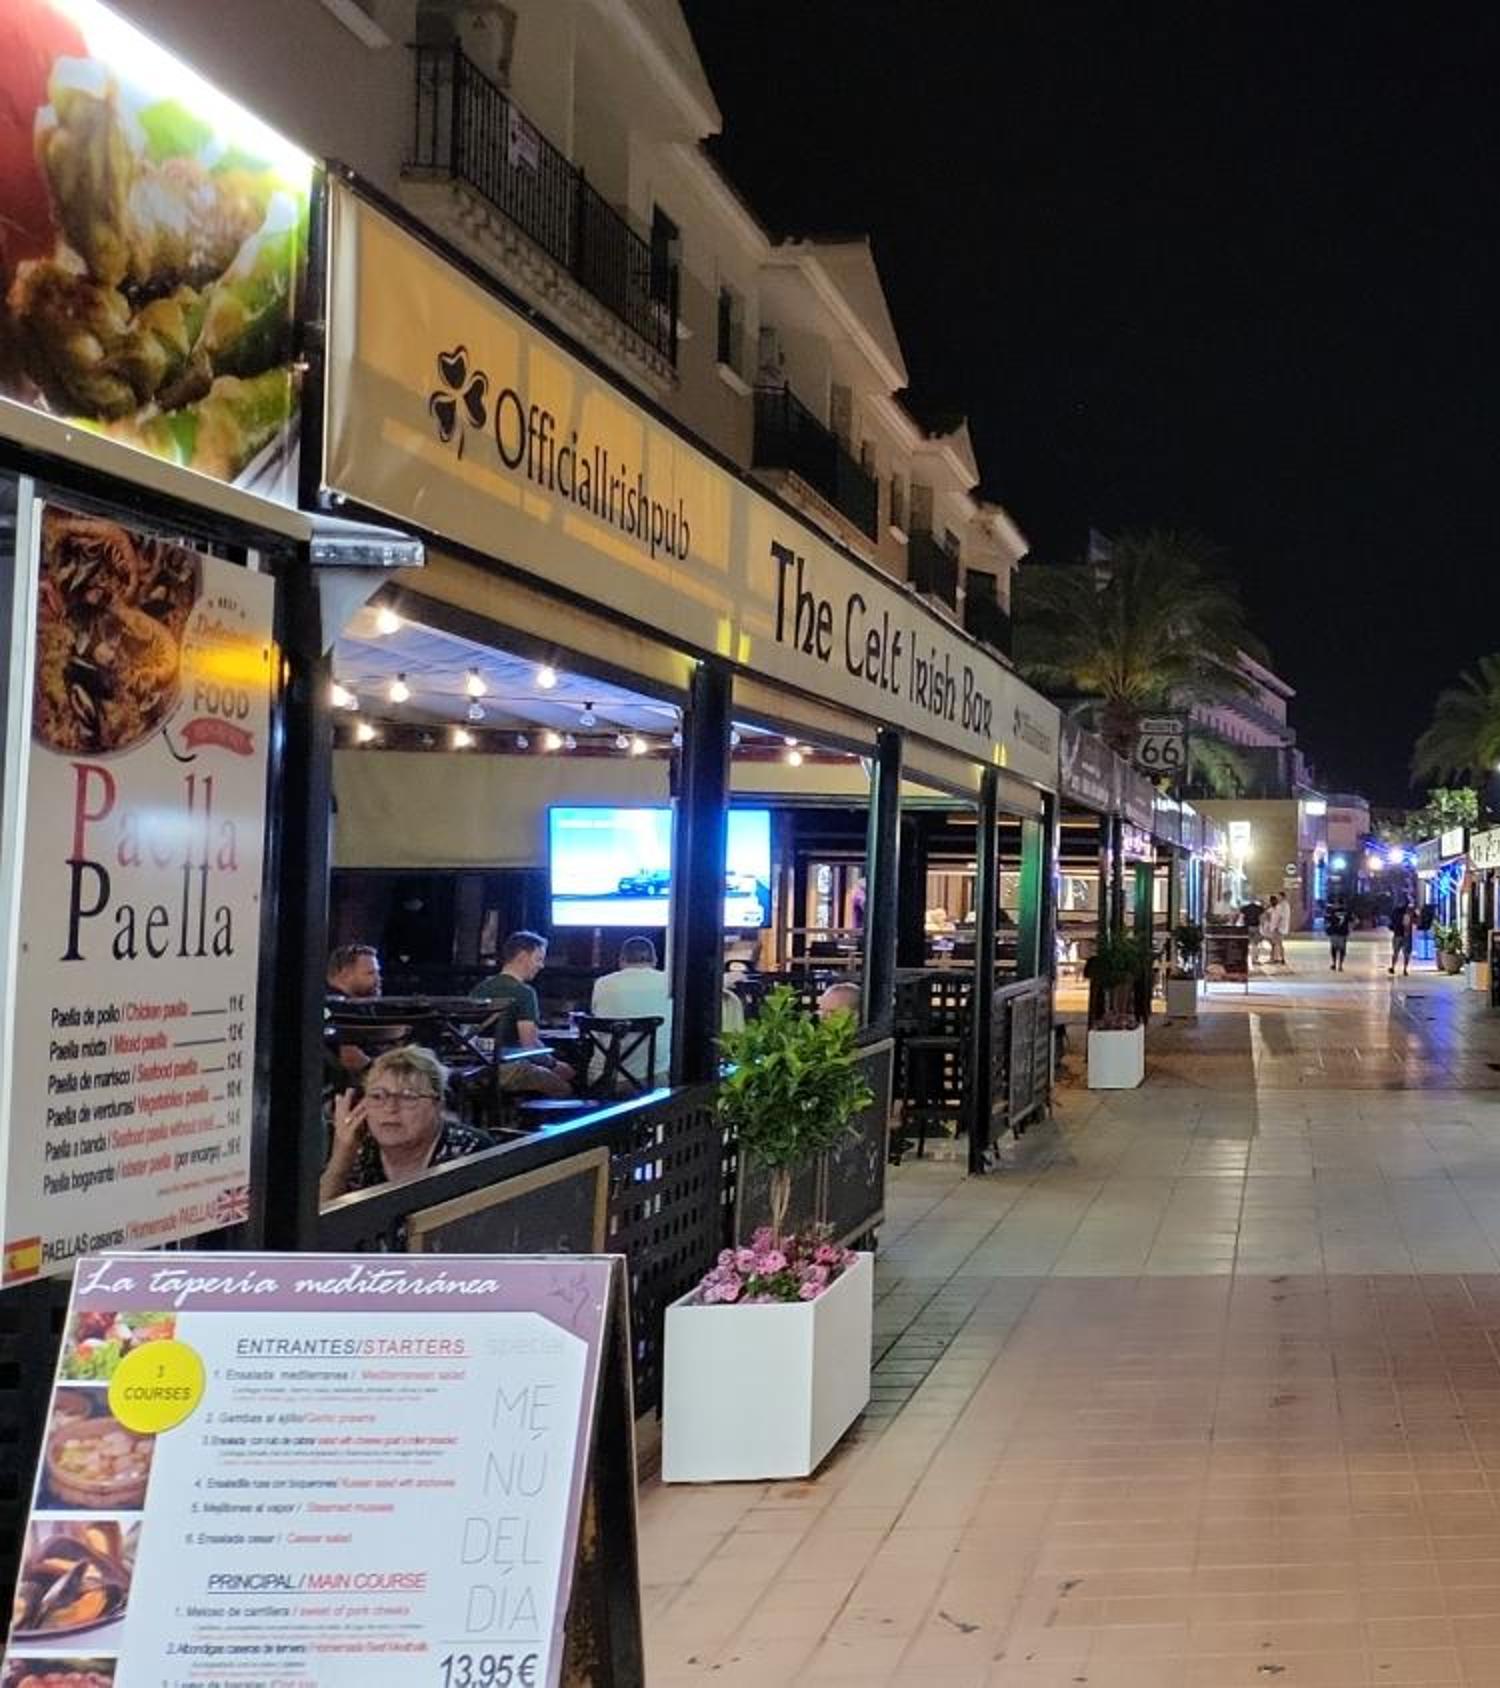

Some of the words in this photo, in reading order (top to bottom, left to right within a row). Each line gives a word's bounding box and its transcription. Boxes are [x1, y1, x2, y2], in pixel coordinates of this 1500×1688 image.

[770, 540, 833, 662] The
[845, 593, 902, 696] Celt
[909, 631, 956, 721] Irish
[194, 684, 250, 720] FOOD
[1142, 738, 1179, 768] 66
[60, 859, 235, 962] Paella
[51, 1007, 81, 1028] Paella
[50, 1040, 79, 1062] Paella
[48, 1072, 78, 1095] Paella
[46, 1105, 77, 1128] Paella
[79, 1259, 137, 1297] La
[147, 1268, 279, 1308] tapería
[294, 1263, 502, 1297] mediterránea
[236, 1338, 467, 1356] ENTRANTES/STARTERS
[123, 1386, 193, 1402] COURSES
[460, 1517, 543, 1565] DEL
[207, 1573, 297, 1589] PRINCIPAL
[307, 1572, 351, 1589] MAIN
[353, 1571, 426, 1589] COURSE
